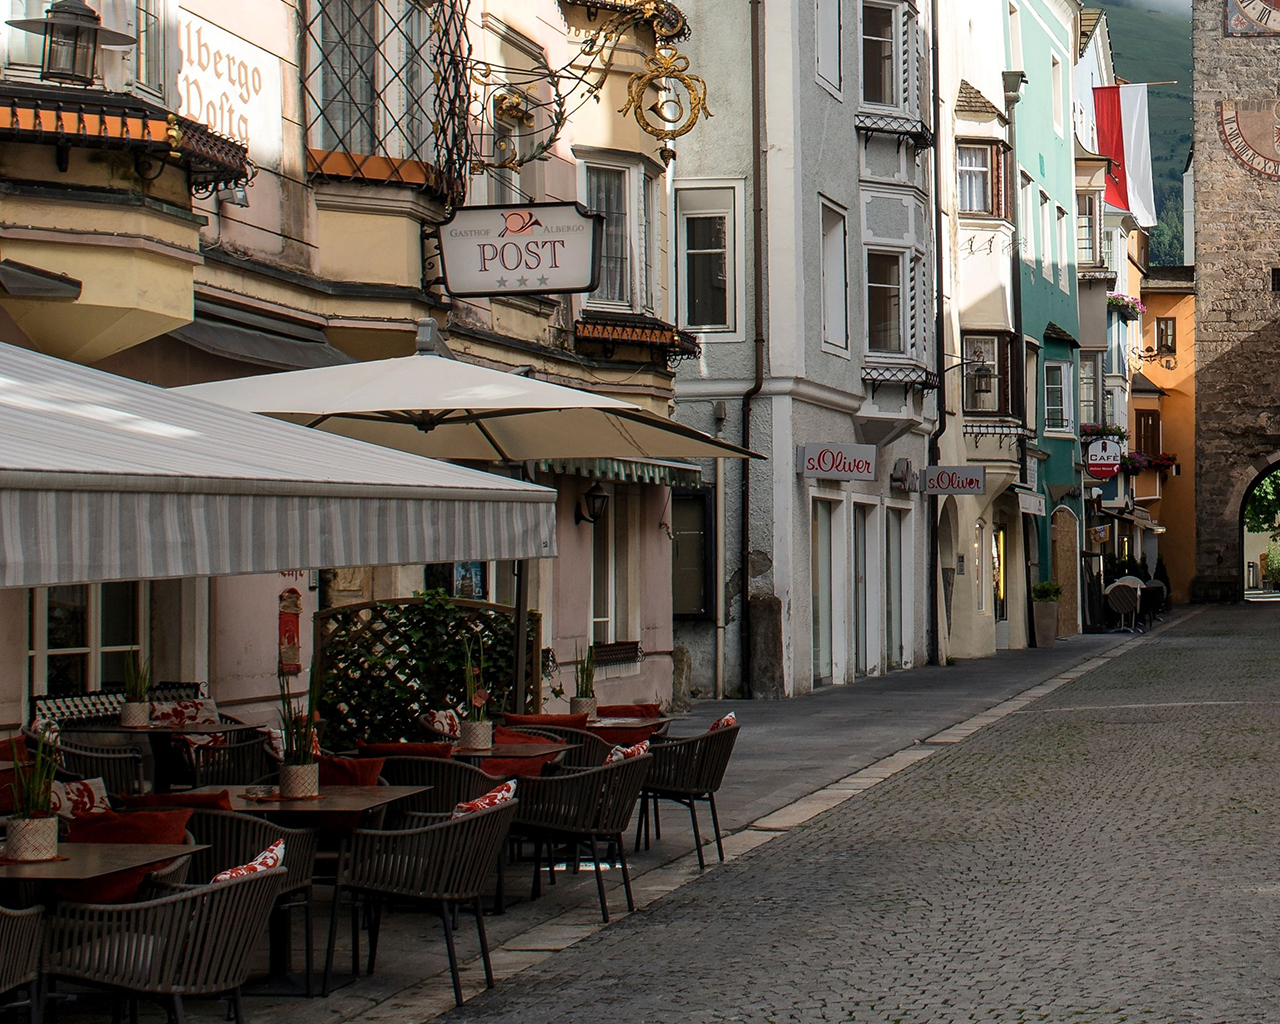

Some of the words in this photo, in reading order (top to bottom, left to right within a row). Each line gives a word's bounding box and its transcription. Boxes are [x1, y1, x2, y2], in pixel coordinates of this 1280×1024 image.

[184, 20, 262, 105] lbergo
[477, 240, 565, 272] POST
[806, 448, 872, 474] s.Oliver
[928, 470, 981, 490] s.Oliver
